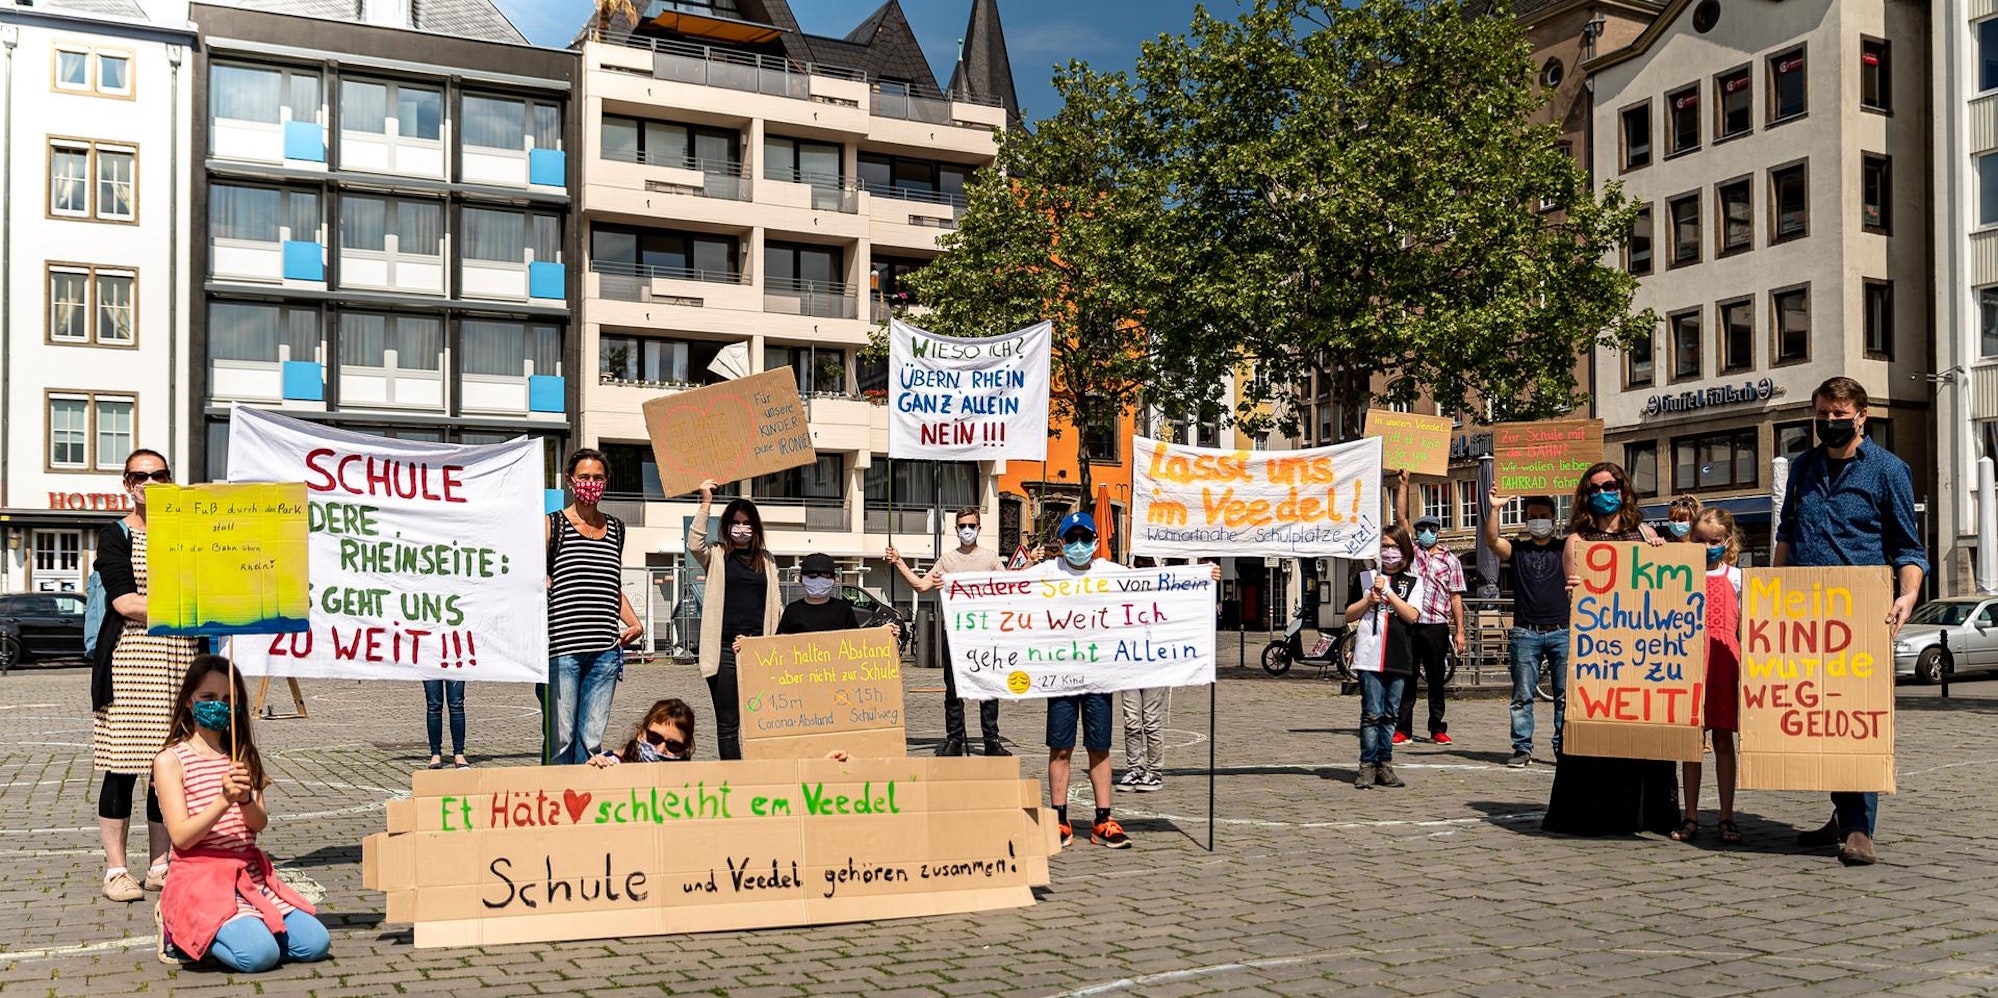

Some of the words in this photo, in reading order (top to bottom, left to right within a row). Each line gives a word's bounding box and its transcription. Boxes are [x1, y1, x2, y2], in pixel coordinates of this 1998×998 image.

[911, 336, 981, 359] WIESO
[988, 337, 1025, 359] ICH?
[753, 392, 772, 406] Für
[897, 392, 953, 414] GANZ
[759, 416, 798, 437] KINDER
[1501, 430, 1519, 443] Zur
[1525, 425, 1563, 443] Schule
[1567, 426, 1586, 440] mit
[305, 448, 468, 503] SCHULE
[1148, 442, 1253, 483] Lasst
[1267, 457, 1333, 484] uns
[1501, 462, 1517, 472] Wir
[1521, 461, 1554, 472] wollen
[1501, 475, 1546, 489] FAHRRAD
[48, 492, 134, 510] HOTEL
[227, 503, 257, 514] durch
[277, 503, 301, 515] Park
[1147, 488, 1187, 525] im
[1202, 486, 1342, 527] Veedel
[211, 543, 237, 552] Bahn
[1584, 543, 1618, 594] 9
[1631, 546, 1693, 591] km
[949, 577, 1032, 600] Andere
[1040, 576, 1111, 599] Seite
[1157, 572, 1209, 592] Rhein
[1750, 576, 1853, 619] Mein
[321, 586, 391, 617] GEHT
[401, 592, 464, 626] UNS
[1121, 601, 1168, 626] Ich
[1574, 590, 1705, 639] Schulweg?
[1577, 634, 1623, 658] Das
[1632, 632, 1688, 666] geht
[1749, 619, 1853, 654] KIND
[754, 647, 785, 667] Wir
[793, 644, 831, 665] halten
[838, 638, 892, 661] Abstand
[966, 645, 1018, 672] gehe
[1028, 640, 1100, 662] nicht
[1748, 649, 1873, 679] wurde
[809, 667, 837, 682] nicht
[842, 669, 857, 681] zur
[860, 658, 900, 682] Schule!
[1576, 660, 1625, 681] mir
[1643, 661, 1683, 682] zu
[1578, 683, 1703, 727] WEIT!
[1743, 680, 1842, 710] WEG-
[850, 706, 899, 725] Schulweg
[441, 795, 473, 832] Et
[750, 795, 791, 817] em
[802, 781, 900, 816] Veedel
[482, 852, 648, 909] Schule
[683, 869, 718, 893] und
[727, 857, 802, 892] Veedel
[823, 857, 909, 898] gehören
[920, 840, 1017, 879] zusammen!
